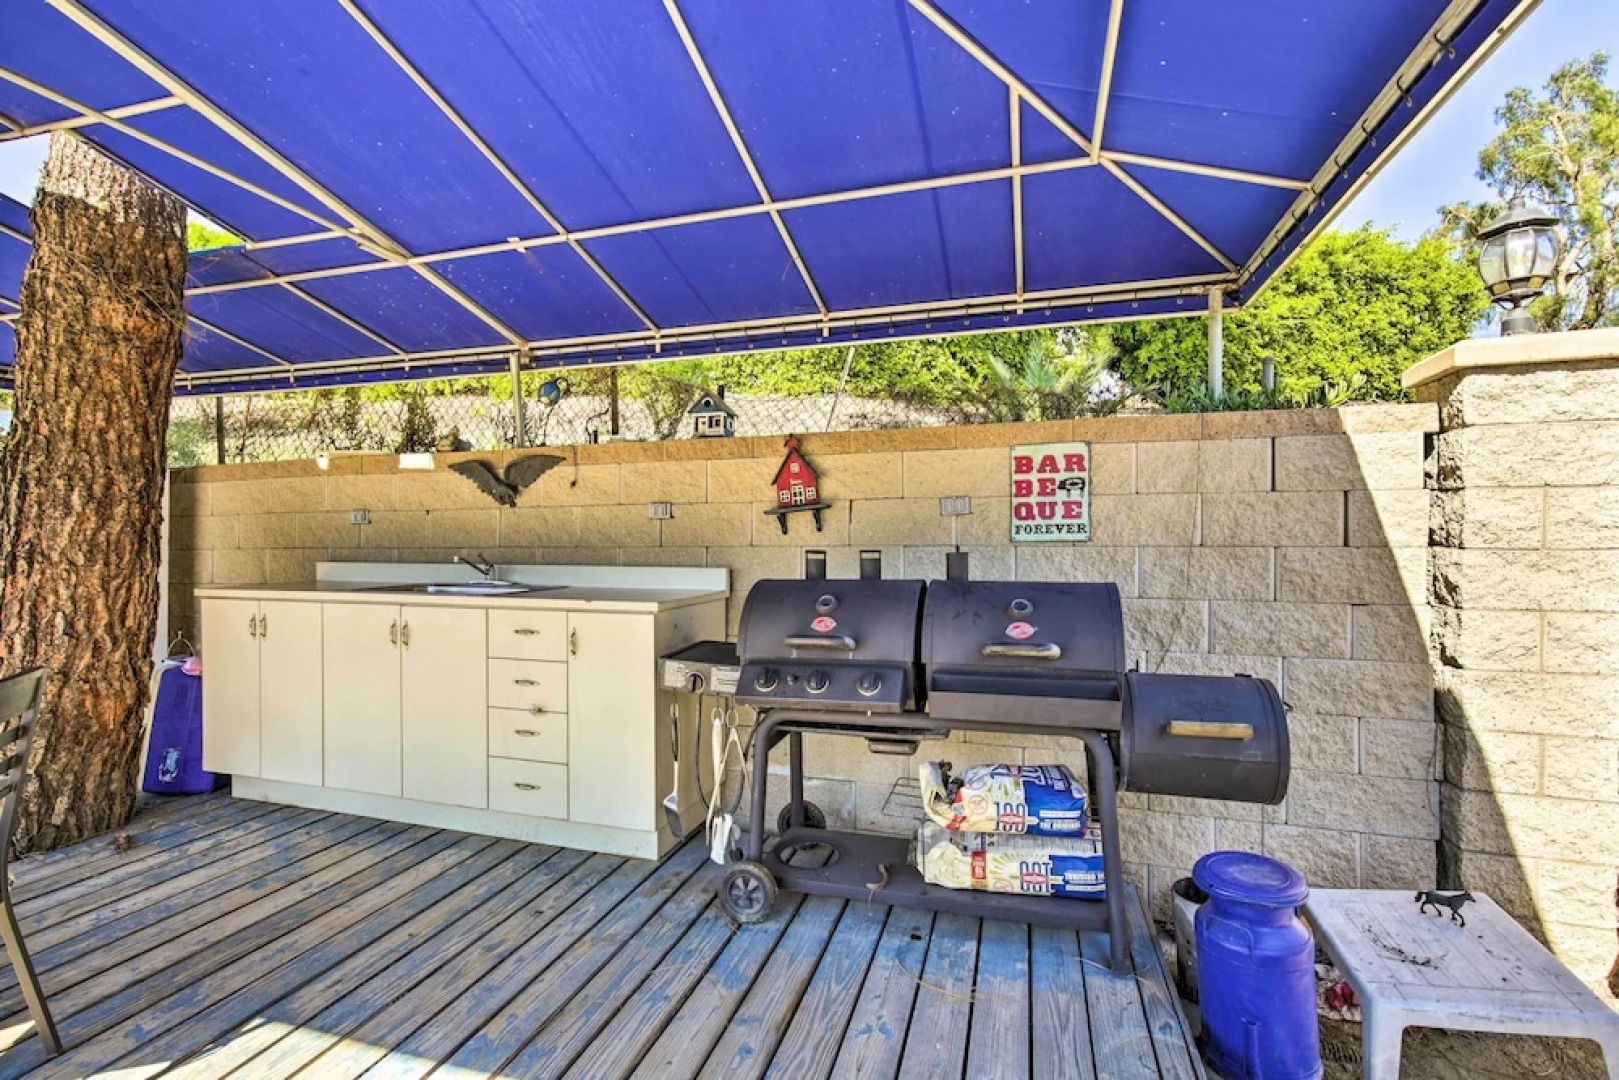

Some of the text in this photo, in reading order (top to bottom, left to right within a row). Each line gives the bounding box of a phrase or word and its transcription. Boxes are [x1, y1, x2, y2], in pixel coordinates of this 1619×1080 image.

[1013, 454, 1086, 474] BAR
[1013, 478, 1057, 498] BE
[1014, 501, 1083, 520] QUE
[1014, 523, 1087, 534] FOREVER
